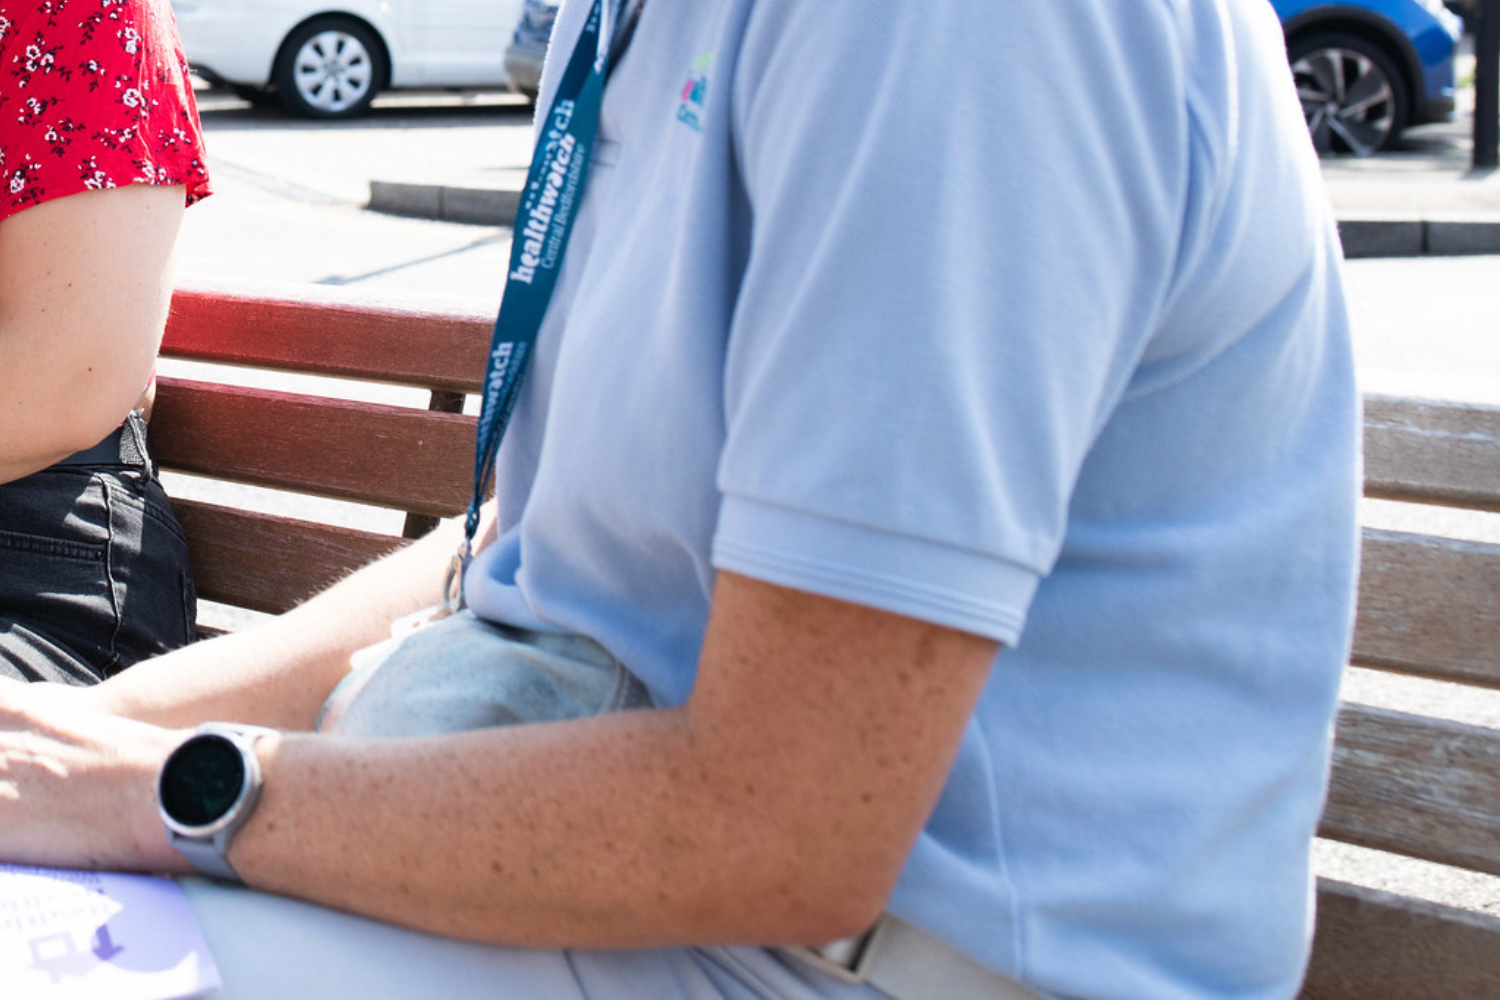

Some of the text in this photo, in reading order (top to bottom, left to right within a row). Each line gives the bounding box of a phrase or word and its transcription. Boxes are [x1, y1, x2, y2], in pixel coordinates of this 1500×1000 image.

[510, 133, 577, 285] healthwatch
[540, 223, 566, 270] Central
[553, 143, 586, 226] Bedfordshire
